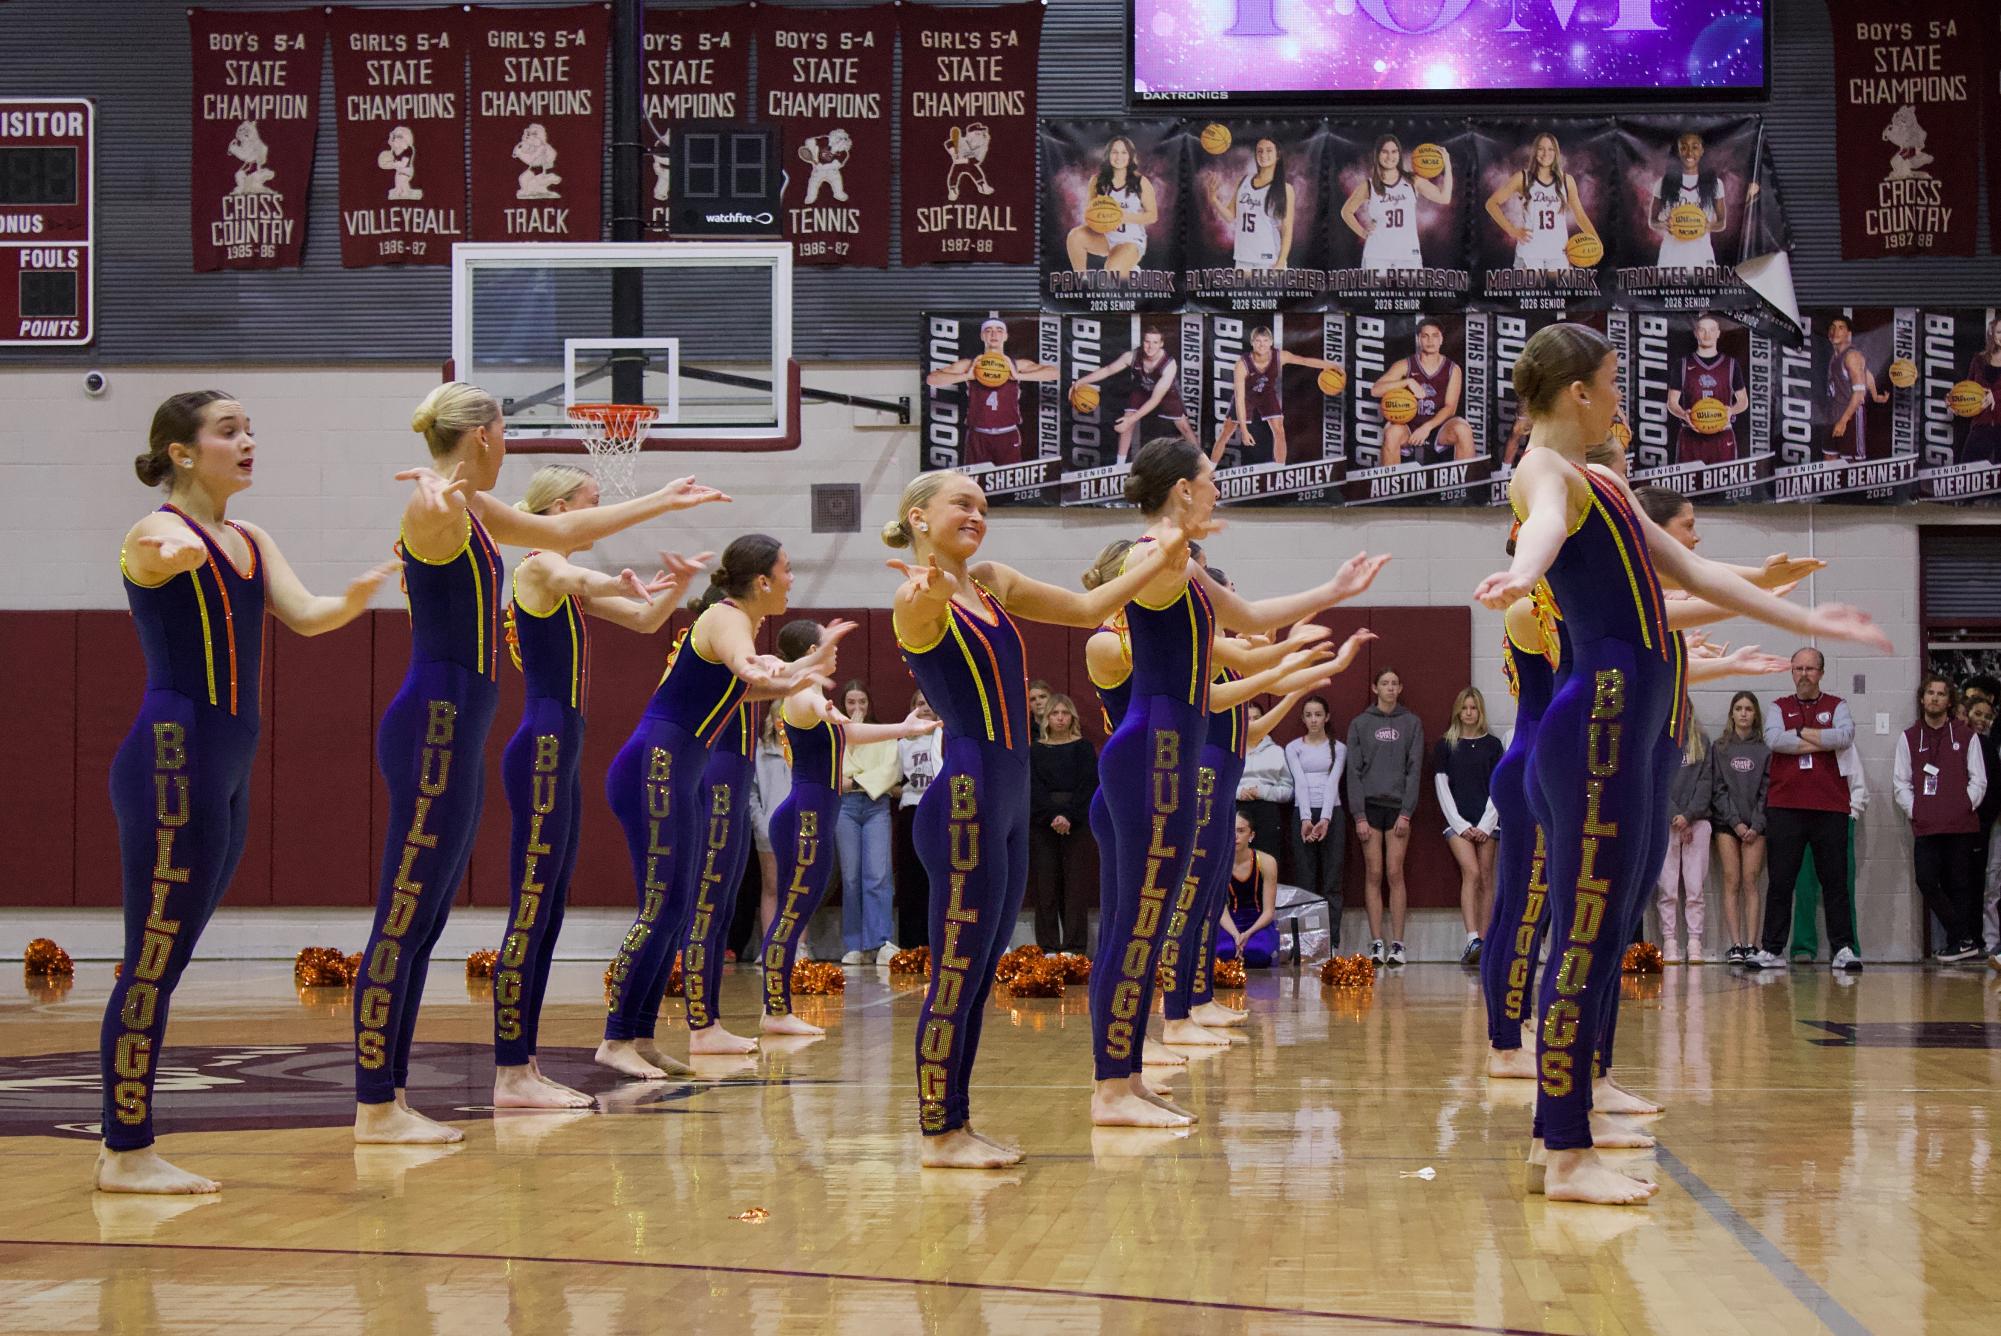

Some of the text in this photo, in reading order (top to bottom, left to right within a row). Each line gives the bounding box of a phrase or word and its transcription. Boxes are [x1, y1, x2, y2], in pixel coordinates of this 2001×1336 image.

[209, 32, 305, 51] BOY'S 5-A
[349, 32, 450, 51] GIRL'S 5-A
[487, 29, 586, 49] GIRL'S 5-A
[643, 32, 731, 51] OY'S 5-A
[775, 30, 875, 50] BOY'S 5-A
[921, 30, 1019, 49] GIRL'S 5-A
[1857, 19, 1957, 41] BOY'S 5-A
[366, 59, 432, 85] STATE
[504, 56, 570, 83] STATE
[647, 59, 714, 85] STATE
[792, 57, 858, 84] STATE
[936, 55, 1003, 82] STATE
[1874, 44, 1941, 73] STATE
[225, 60, 287, 86] STATE
[481, 89, 592, 117] CHAMPIONS
[1143, 91, 1229, 100] DAKTRONICS
[1849, 75, 1967, 104] CHAMPIONS
[203, 94, 308, 120] CHAMPION
[347, 93, 455, 121] CHAMPIONS
[643, 92, 736, 119] AMPIONS
[768, 90, 881, 119] CHAMPIONS
[912, 90, 1025, 117] CHAMPIONS
[0, 111, 84, 137] ISITOR
[222, 193, 283, 220] CROSS
[1879, 179, 1942, 207] CROSS
[343, 207, 461, 235] VOLLEYBALL
[504, 207, 569, 234] TRACK
[705, 212, 752, 224] watchfire
[788, 207, 860, 234] TENNIS
[917, 204, 1017, 233] SOFTBALL
[1242, 213, 1256, 232] 15
[1385, 209, 1404, 228] 30
[1538, 210, 1555, 230] 13
[1865, 207, 1952, 235] COUNTRY
[211, 219, 294, 246] COUNTRY
[20, 248, 79, 268] FOULS
[1386, 267, 1469, 291] PETERSON
[1693, 265, 1744, 289] PALM
[1090, 300, 1136, 311] 2026 SENIOR
[1231, 299, 1277, 310] 2026 SENIOR
[1374, 299, 1420, 310] 2026 SENIOR
[1520, 298, 1566, 310] 2026 SENIOR
[1664, 297, 1710, 309] 2026 SENIOR
[19, 319, 79, 337] POINTS
[1041, 321, 1059, 362] EMHS
[1183, 321, 1200, 362] EMHS
[1326, 321, 1343, 362] EMHS
[1468, 320, 1485, 362] EMHS
[1895, 318, 1912, 359] EMHS
[986, 391, 998, 411] 4
[1638, 313, 1668, 467] BULLDOG
[1924, 312, 1954, 467] BULLDOG
[1751, 364, 1769, 455] BASKETBALL
[985, 464, 1047, 492] SHERIFF
[1077, 467, 1113, 479] SENIOR
[1219, 465, 1254, 478] SENIOR
[1221, 463, 1334, 500] BODE LASHLEY
[1360, 465, 1396, 478] SENIOR
[1370, 464, 1469, 498] AUSTIN IBAY
[1645, 465, 1681, 477] SENIOR
[1702, 462, 1757, 490] BICKLE
[1776, 459, 1917, 498] DIANTRE BENNETT
[1787, 463, 1824, 475] SENIOR
[1931, 465, 1967, 477] SENIOR
[1014, 489, 1041, 501] 2026
[1297, 489, 1324, 501] 2026
[1440, 489, 1467, 501] 2026
[1725, 488, 1752, 500] 2026
[1866, 487, 1893, 500] 2026
[358, 700, 458, 1071] BULLDOGS
[496, 733, 560, 1041] BULLDOGS
[606, 746, 673, 1014] BULLDOGS
[1540, 667, 1626, 1098] BULLDOGS
[684, 783, 732, 1028] BULLDOGS
[1106, 728, 1181, 1062] BULLDOGS
[114, 720, 192, 1126] BULLDOGS
[764, 810, 821, 1016] BULLDOGS
[1503, 823, 1548, 1020] LLDOGS
[918, 773, 980, 1130] BULLDOGS
